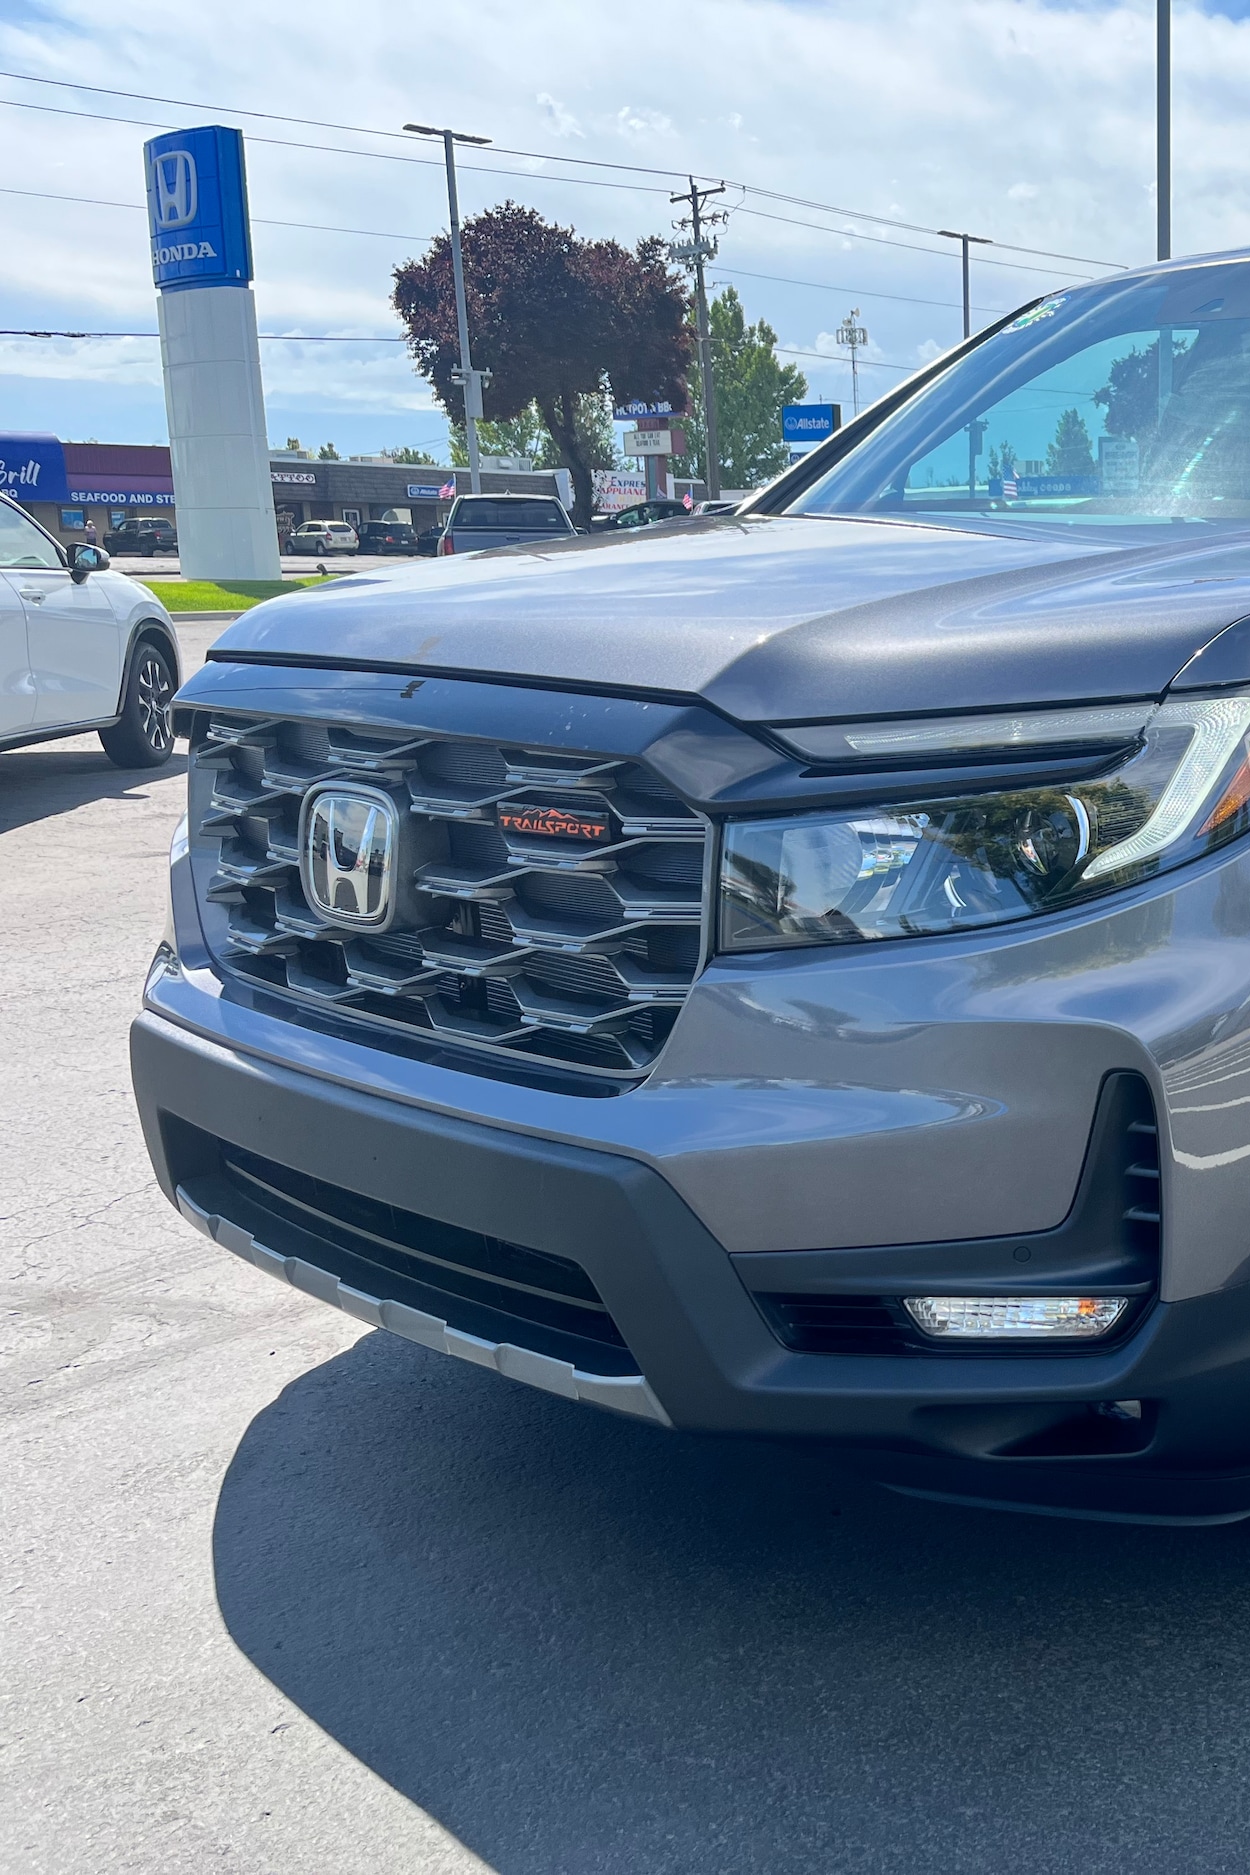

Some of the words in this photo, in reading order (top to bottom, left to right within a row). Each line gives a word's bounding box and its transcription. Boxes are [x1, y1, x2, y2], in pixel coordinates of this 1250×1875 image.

[152, 241, 217, 266] HONDA
[796, 417, 830, 430] Allstate
[71, 491, 126, 503] SEAFOOD
[129, 493, 153, 504] AND
[500, 815, 605, 839] TRAILSPORT
